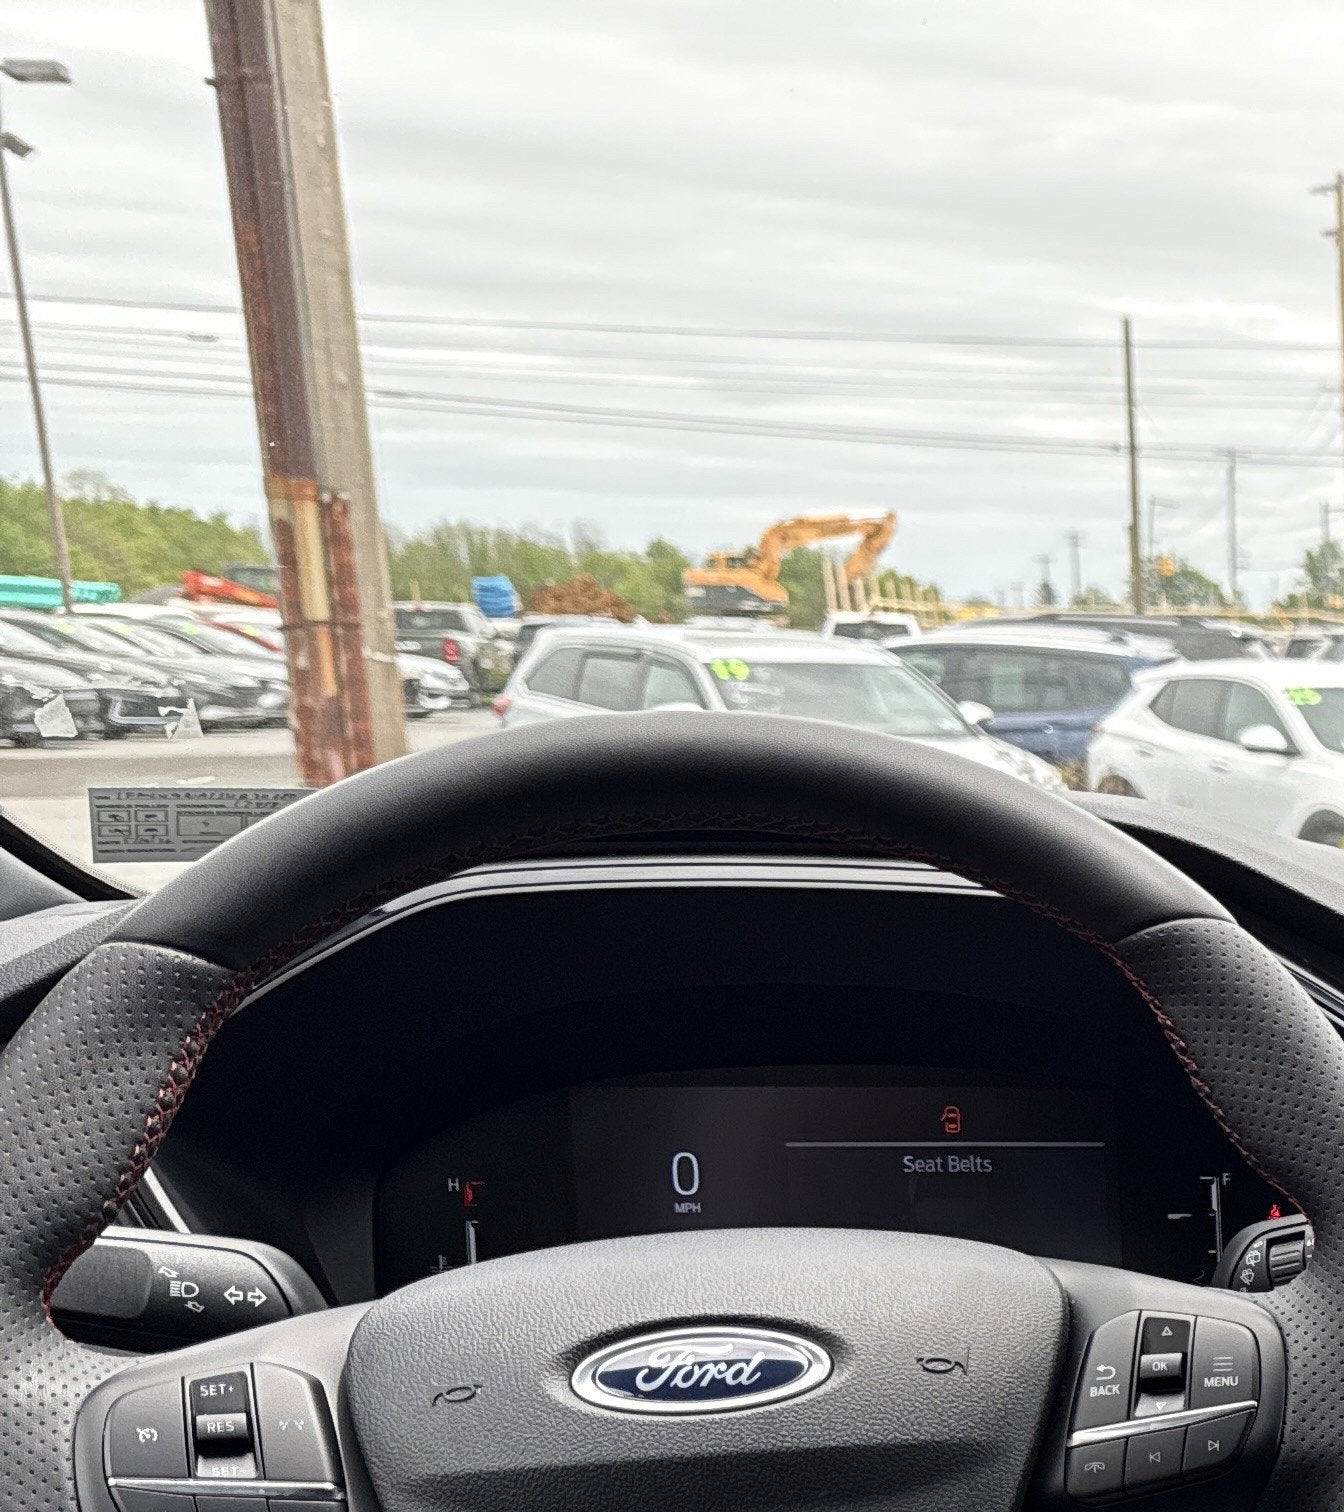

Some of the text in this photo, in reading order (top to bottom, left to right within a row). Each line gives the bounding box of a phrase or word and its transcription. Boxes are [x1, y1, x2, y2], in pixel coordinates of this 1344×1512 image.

[902, 1154, 993, 1174] Seat Belts
[671, 1151, 701, 1197] 0
[447, 1177, 460, 1192] H
[674, 1201, 702, 1214] MPH
[634, 1342, 763, 1390] Ford
[1152, 1360, 1169, 1372] OK
[1203, 1375, 1239, 1388] MENU
[1089, 1383, 1121, 1398] BACK
[206, 1420, 235, 1433] RES
